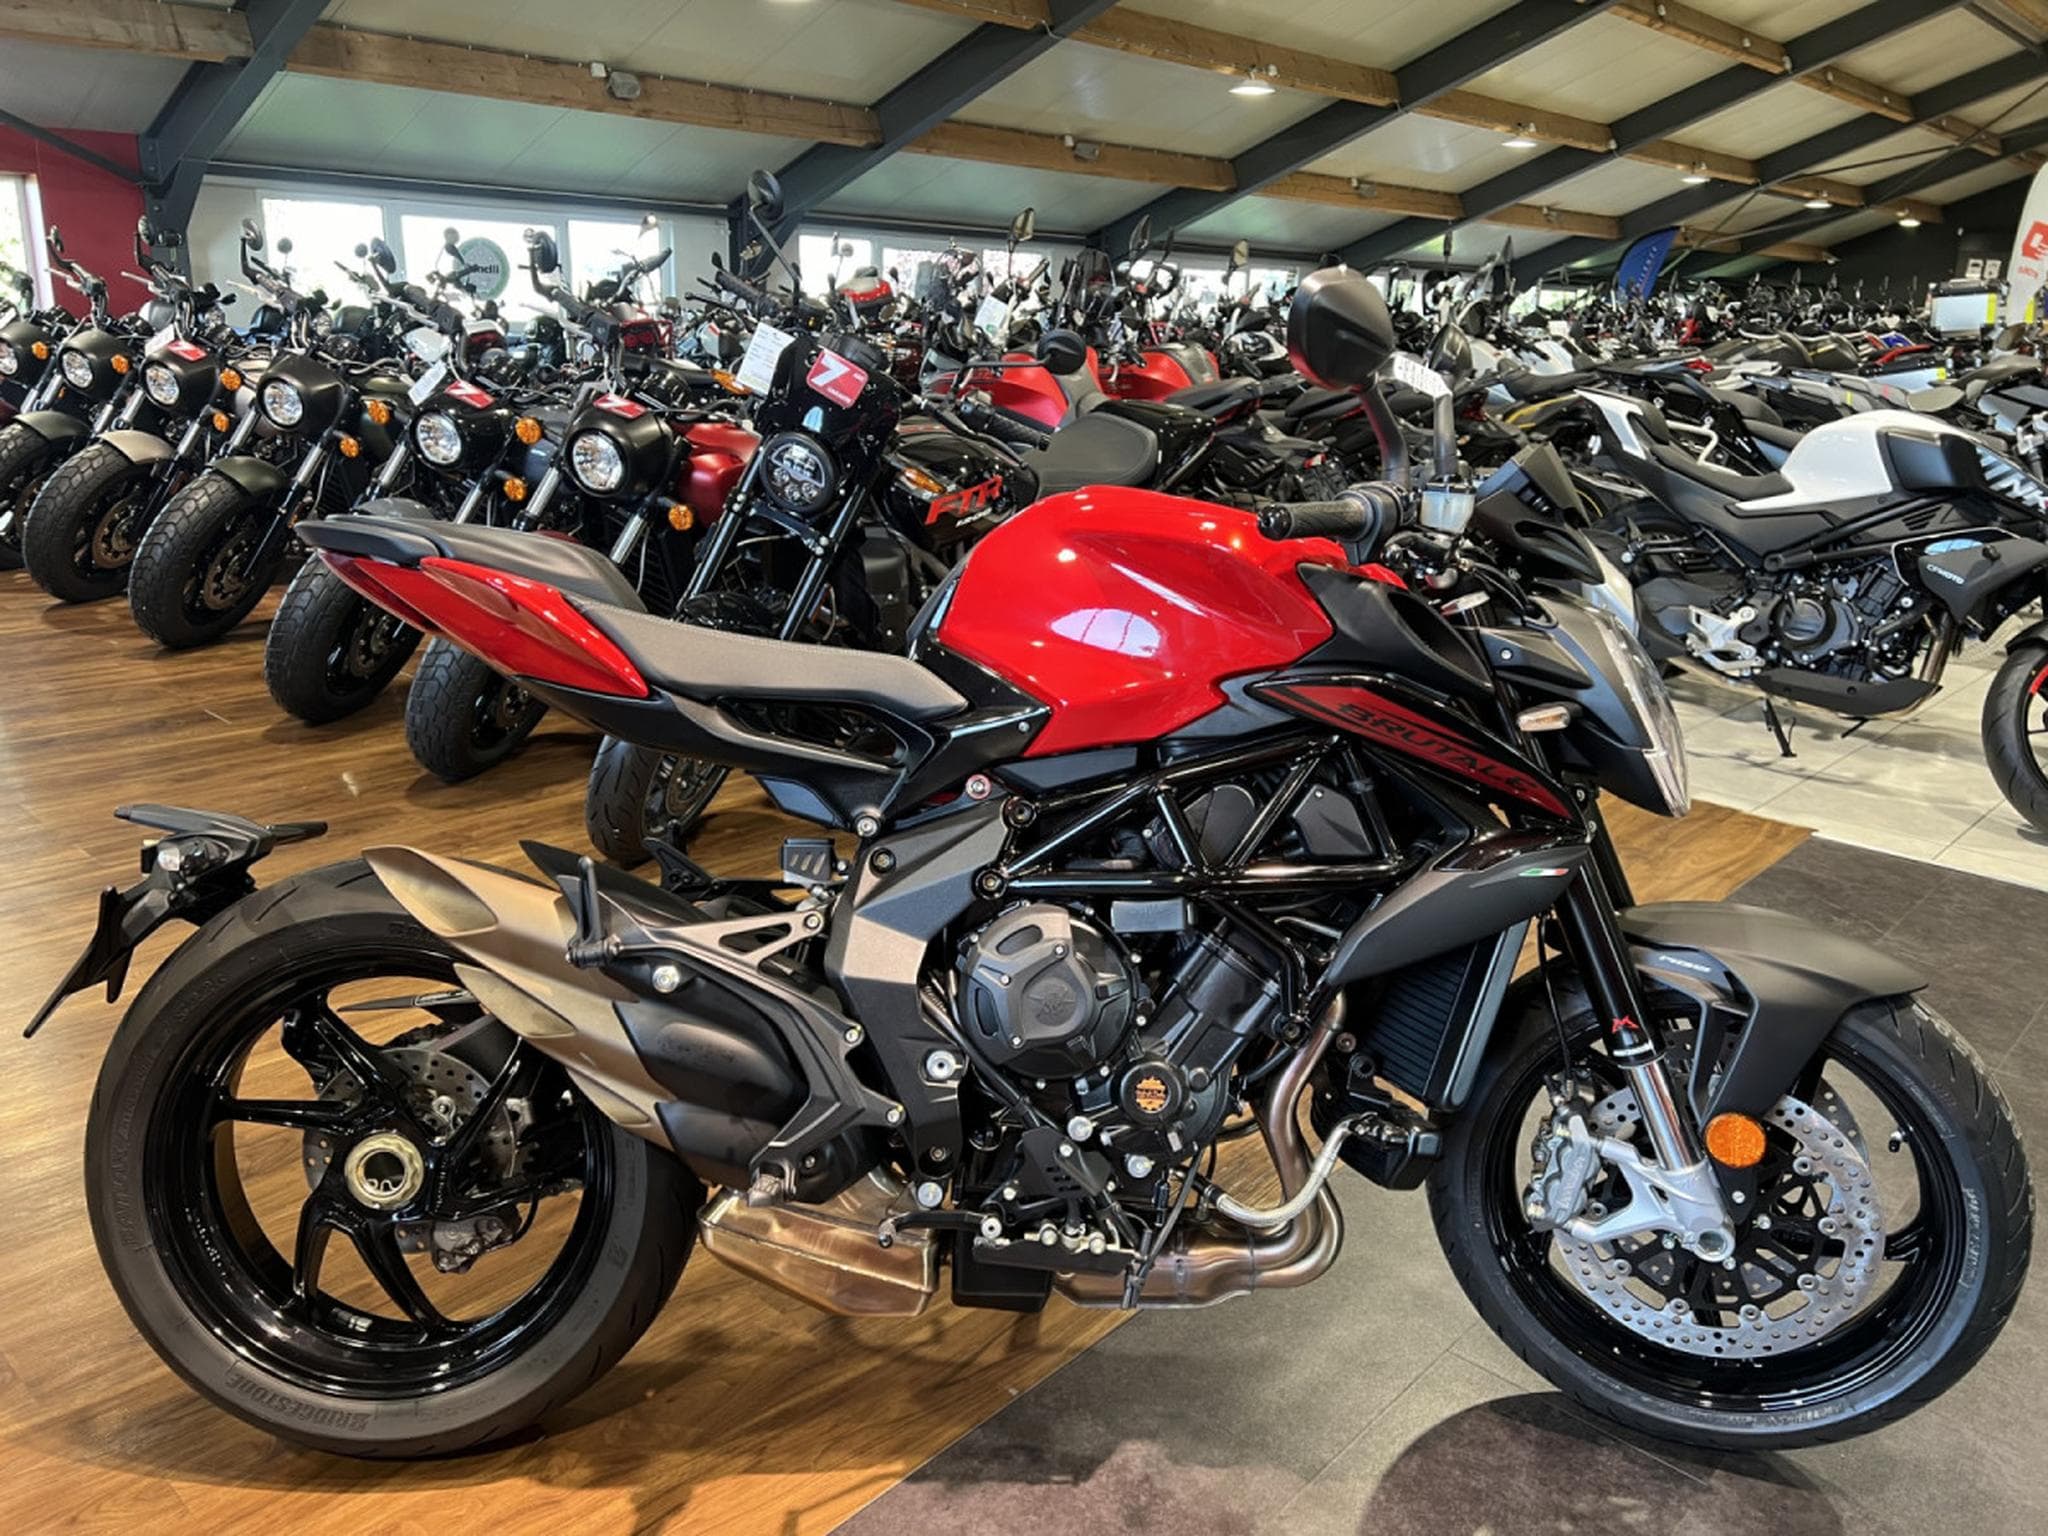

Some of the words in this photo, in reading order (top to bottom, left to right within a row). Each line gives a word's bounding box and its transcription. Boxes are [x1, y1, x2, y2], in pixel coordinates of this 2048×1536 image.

[810, 353, 851, 387] 7
[924, 473, 1003, 526] FTR
[1926, 563, 1965, 585] CFMOTO
[1337, 703, 1539, 793] BRUTALE
[225, 1372, 371, 1433] BRIDGESTONE
